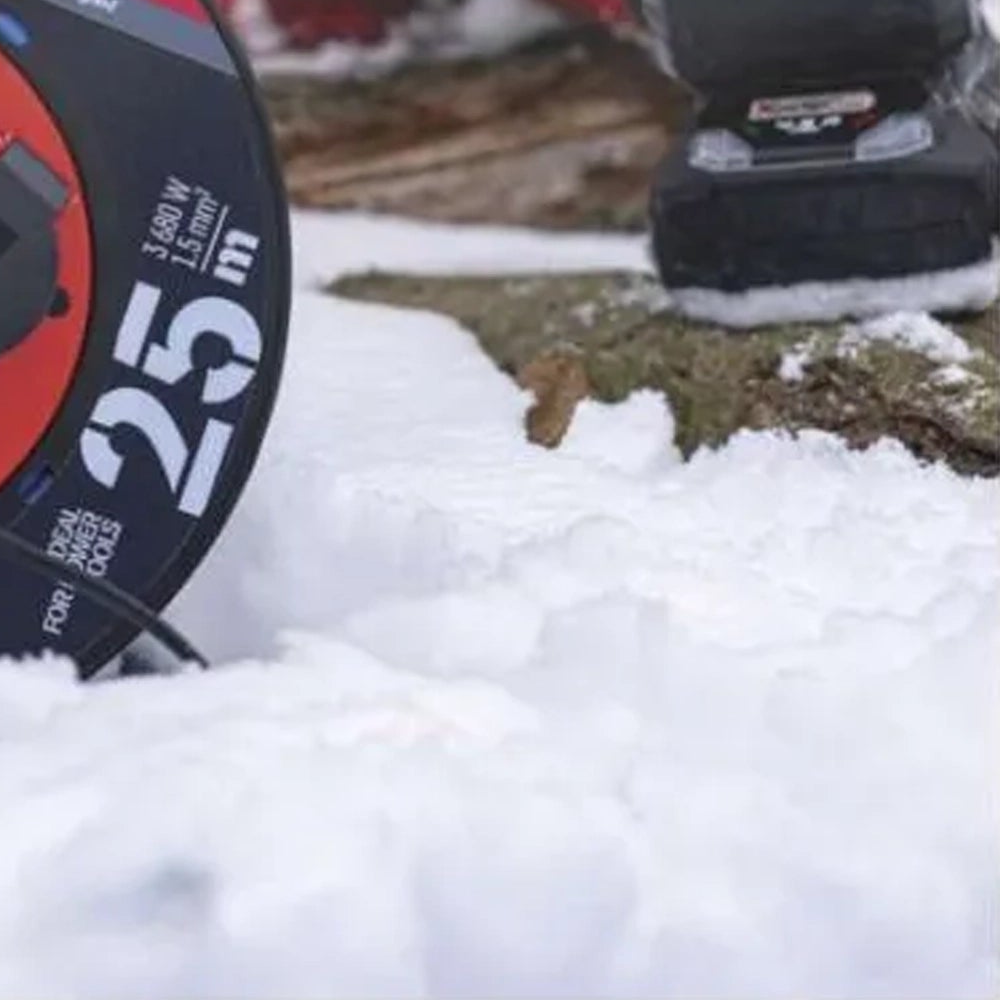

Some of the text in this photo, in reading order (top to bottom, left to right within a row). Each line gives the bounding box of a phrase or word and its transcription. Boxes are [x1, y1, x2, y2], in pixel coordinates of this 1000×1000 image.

[141, 175, 192, 260] 3 680 W
[170, 236, 202, 268] 1.5
[80, 229, 263, 518] 25 m
[47, 508, 82, 560] DEAL
[86, 520, 122, 577] OOLS
[42, 589, 75, 635] FOR
